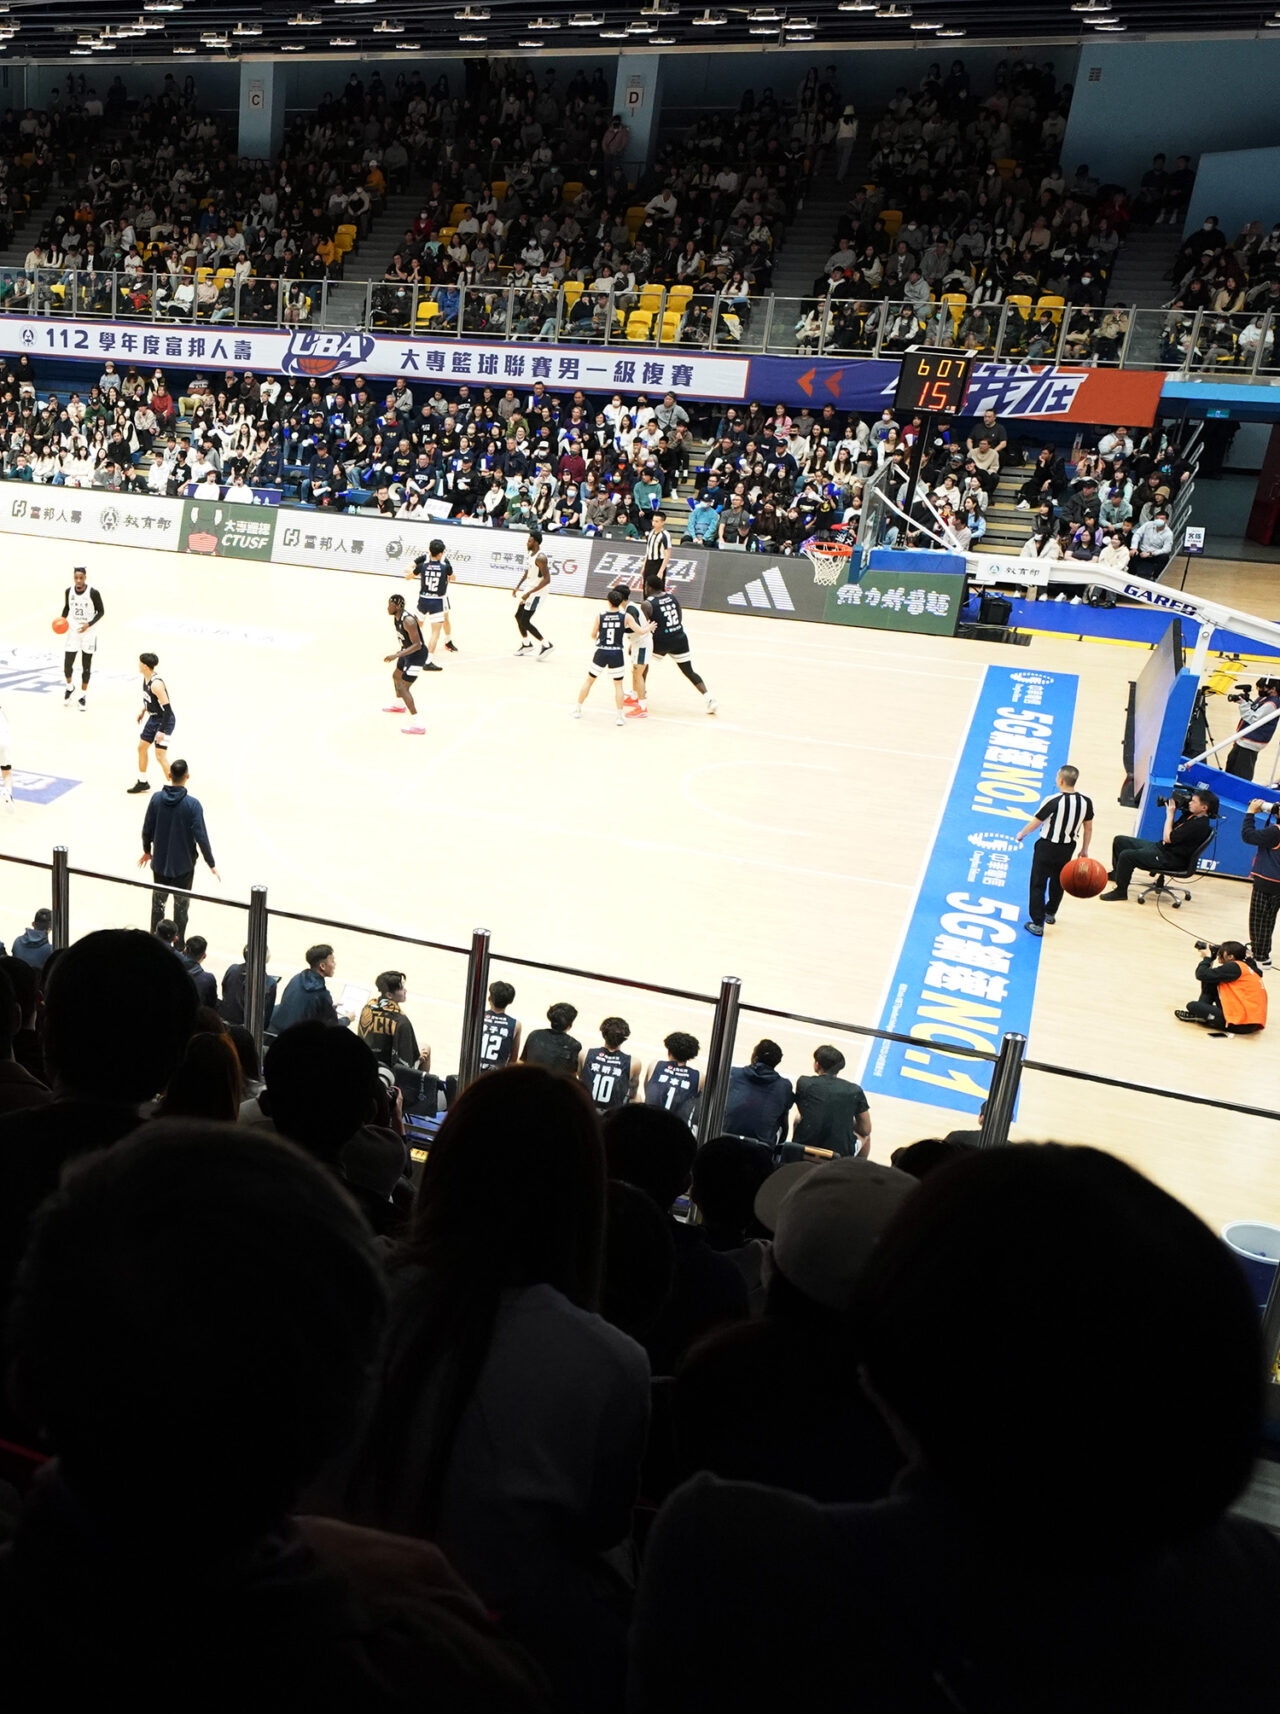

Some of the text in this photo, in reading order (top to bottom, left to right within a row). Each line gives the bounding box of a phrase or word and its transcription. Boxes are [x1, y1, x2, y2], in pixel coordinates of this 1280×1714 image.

[46, 328, 693, 388] 112 學年度富邦人壽 UBA 大專籃球聯賽男一級複賽
[918, 381, 952, 410] 15
[221, 533, 269, 550] CTUSF
[304, 534, 365, 555] 富邦人壽
[424, 577, 440, 592] 42
[1124, 584, 1198, 616] GARED
[663, 609, 680, 627] 32
[605, 628, 615, 645] 9
[481, 1033, 503, 1061] 12
[592, 1073, 615, 1103] 10
[665, 1086, 676, 1110] 1
